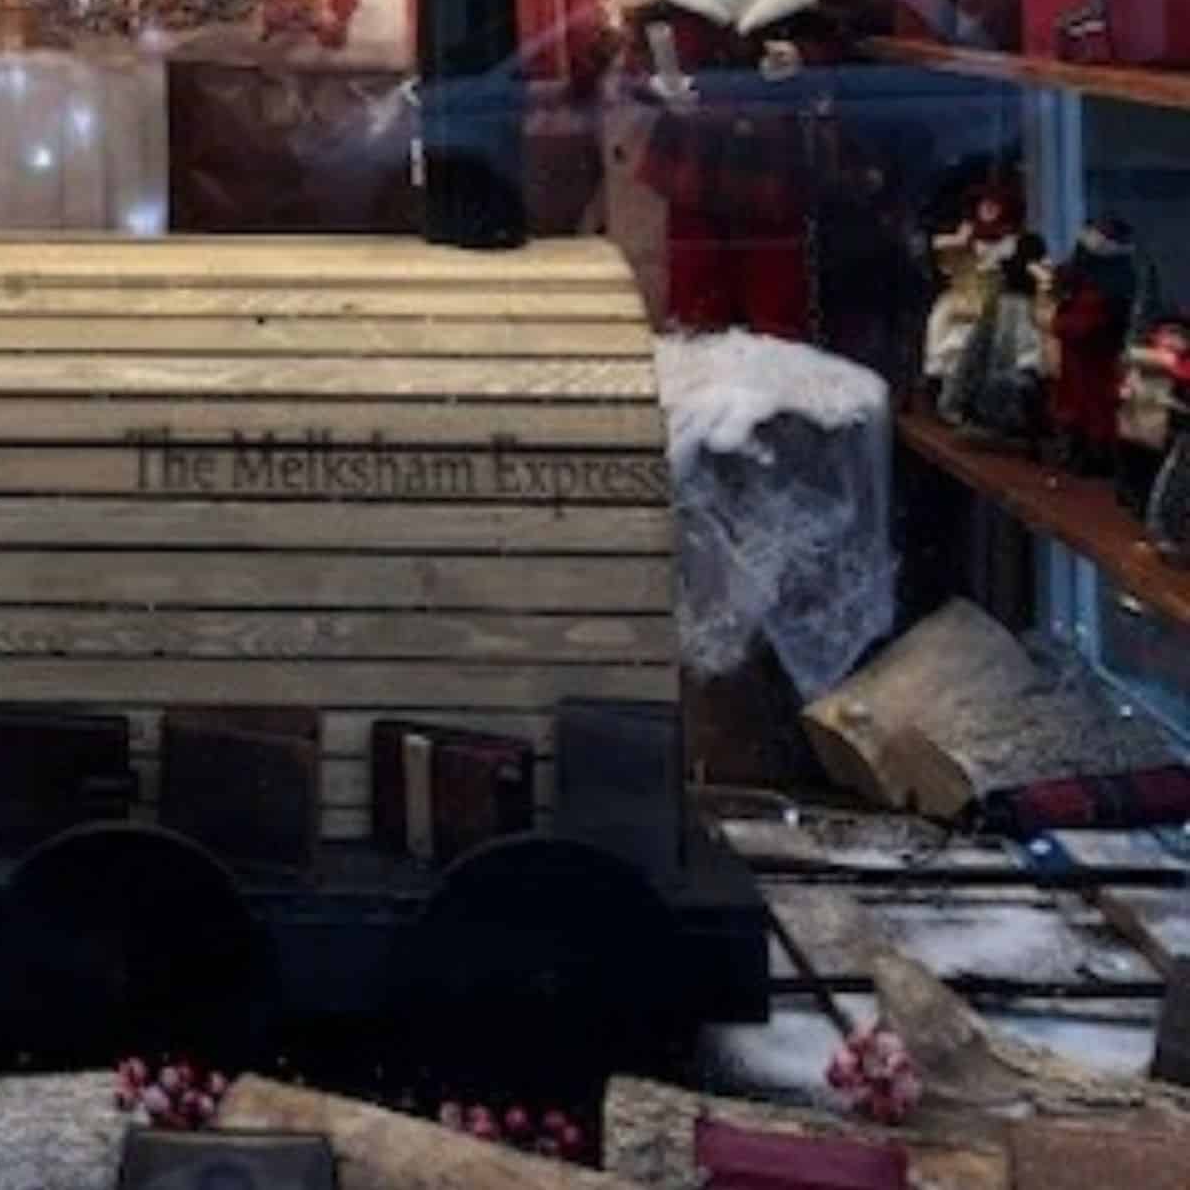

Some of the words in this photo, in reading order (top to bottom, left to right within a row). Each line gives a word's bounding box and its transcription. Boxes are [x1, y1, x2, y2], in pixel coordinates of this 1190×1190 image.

[123, 426, 216, 492] The
[231, 427, 474, 496] Melksham
[491, 432, 671, 521] Express
